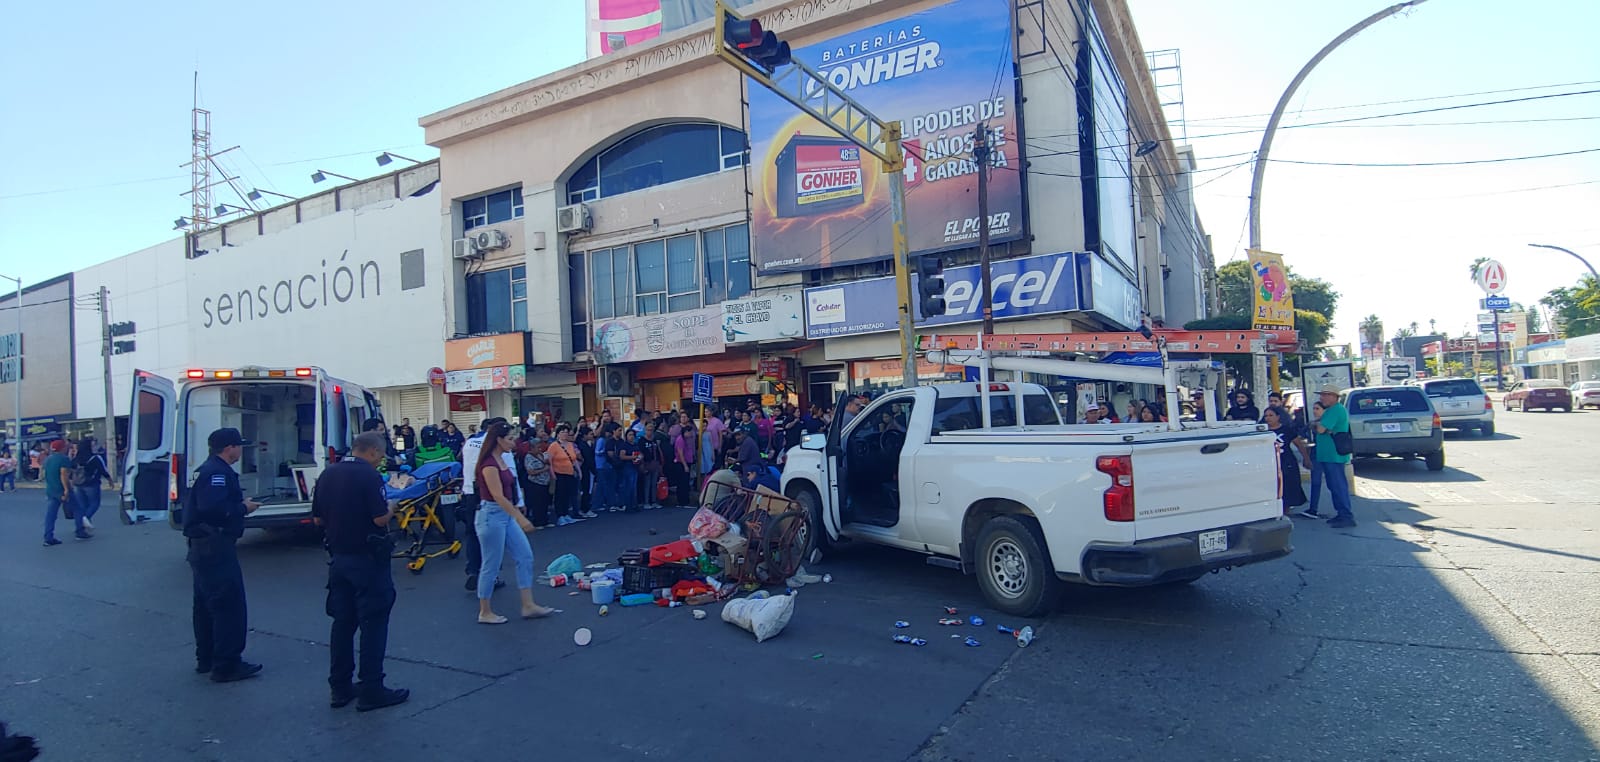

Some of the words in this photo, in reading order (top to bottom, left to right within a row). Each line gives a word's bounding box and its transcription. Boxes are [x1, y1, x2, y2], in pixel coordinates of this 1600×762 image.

[822, 25, 922, 62] BATERÍAS
[913, 104, 976, 136] PODER
[980, 97, 1005, 121] DE
[925, 133, 975, 161] AÑOS
[925, 147, 1008, 182] GARANÍA
[801, 170, 858, 190] GONHER
[944, 220, 959, 235] EL
[203, 249, 381, 329] sensación
[931, 257, 1068, 316] elcel
[735, 314, 743, 324] EL
[746, 311, 770, 323] CHAVO
